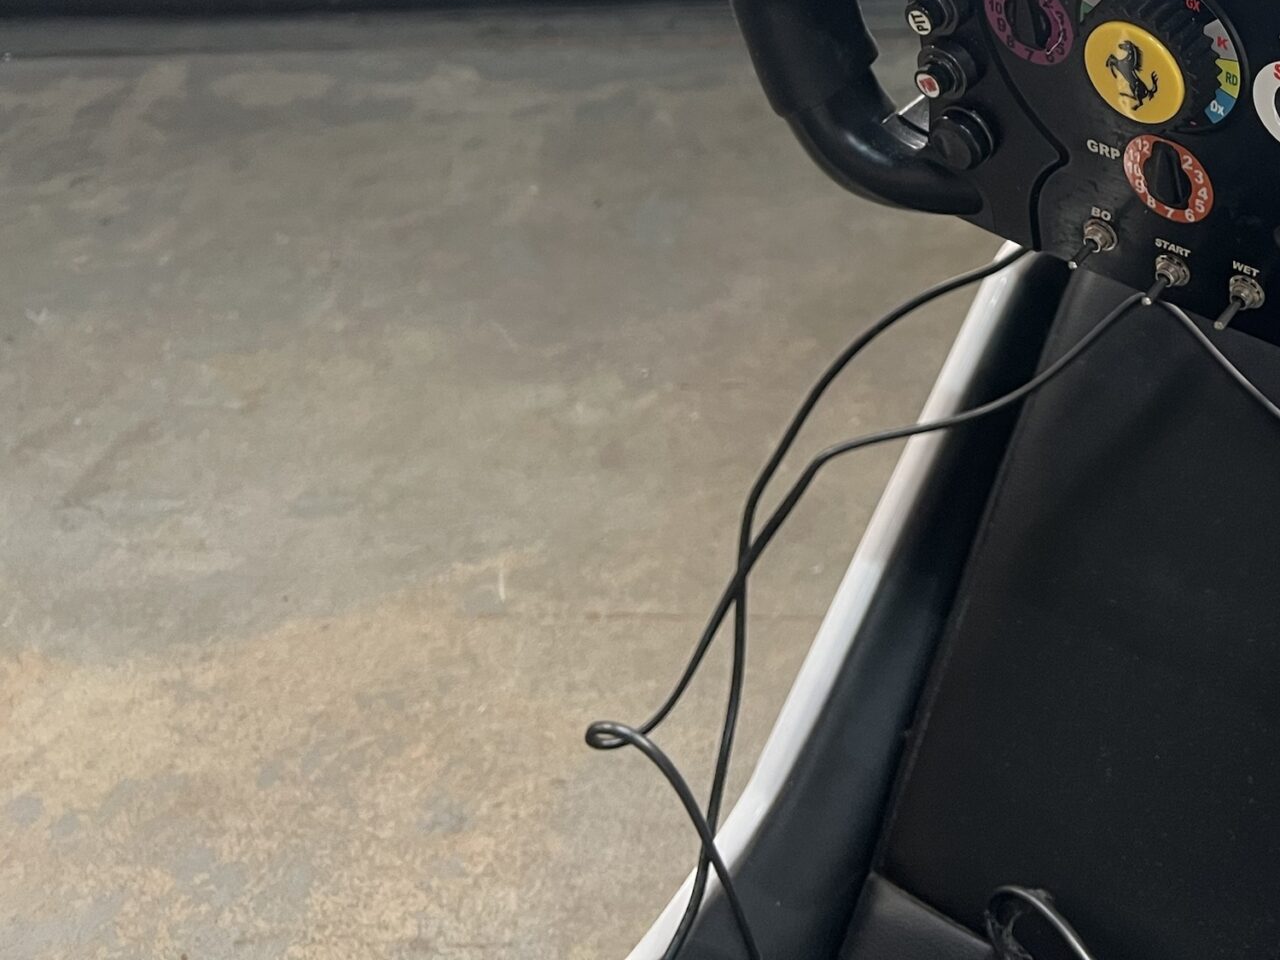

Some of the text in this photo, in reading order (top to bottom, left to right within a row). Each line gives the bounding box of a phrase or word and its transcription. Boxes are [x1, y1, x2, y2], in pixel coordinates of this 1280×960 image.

[911, 12, 929, 31] PIT
[1225, 73, 1238, 87] RD
[1086, 139, 1120, 161] GRP
[1136, 138, 1151, 154] 12
[1182, 155, 1193, 170] 2
[1193, 170, 1204, 184] 3
[1147, 194, 1156, 208] 8
[1198, 187, 1208, 201] 4
[1164, 206, 1174, 219] 7
[1195, 198, 1205, 213] 5
[1091, 206, 1112, 221] BO
[1184, 208, 1195, 222] 6
[1155, 238, 1191, 258] START
[1232, 260, 1260, 277] WET
